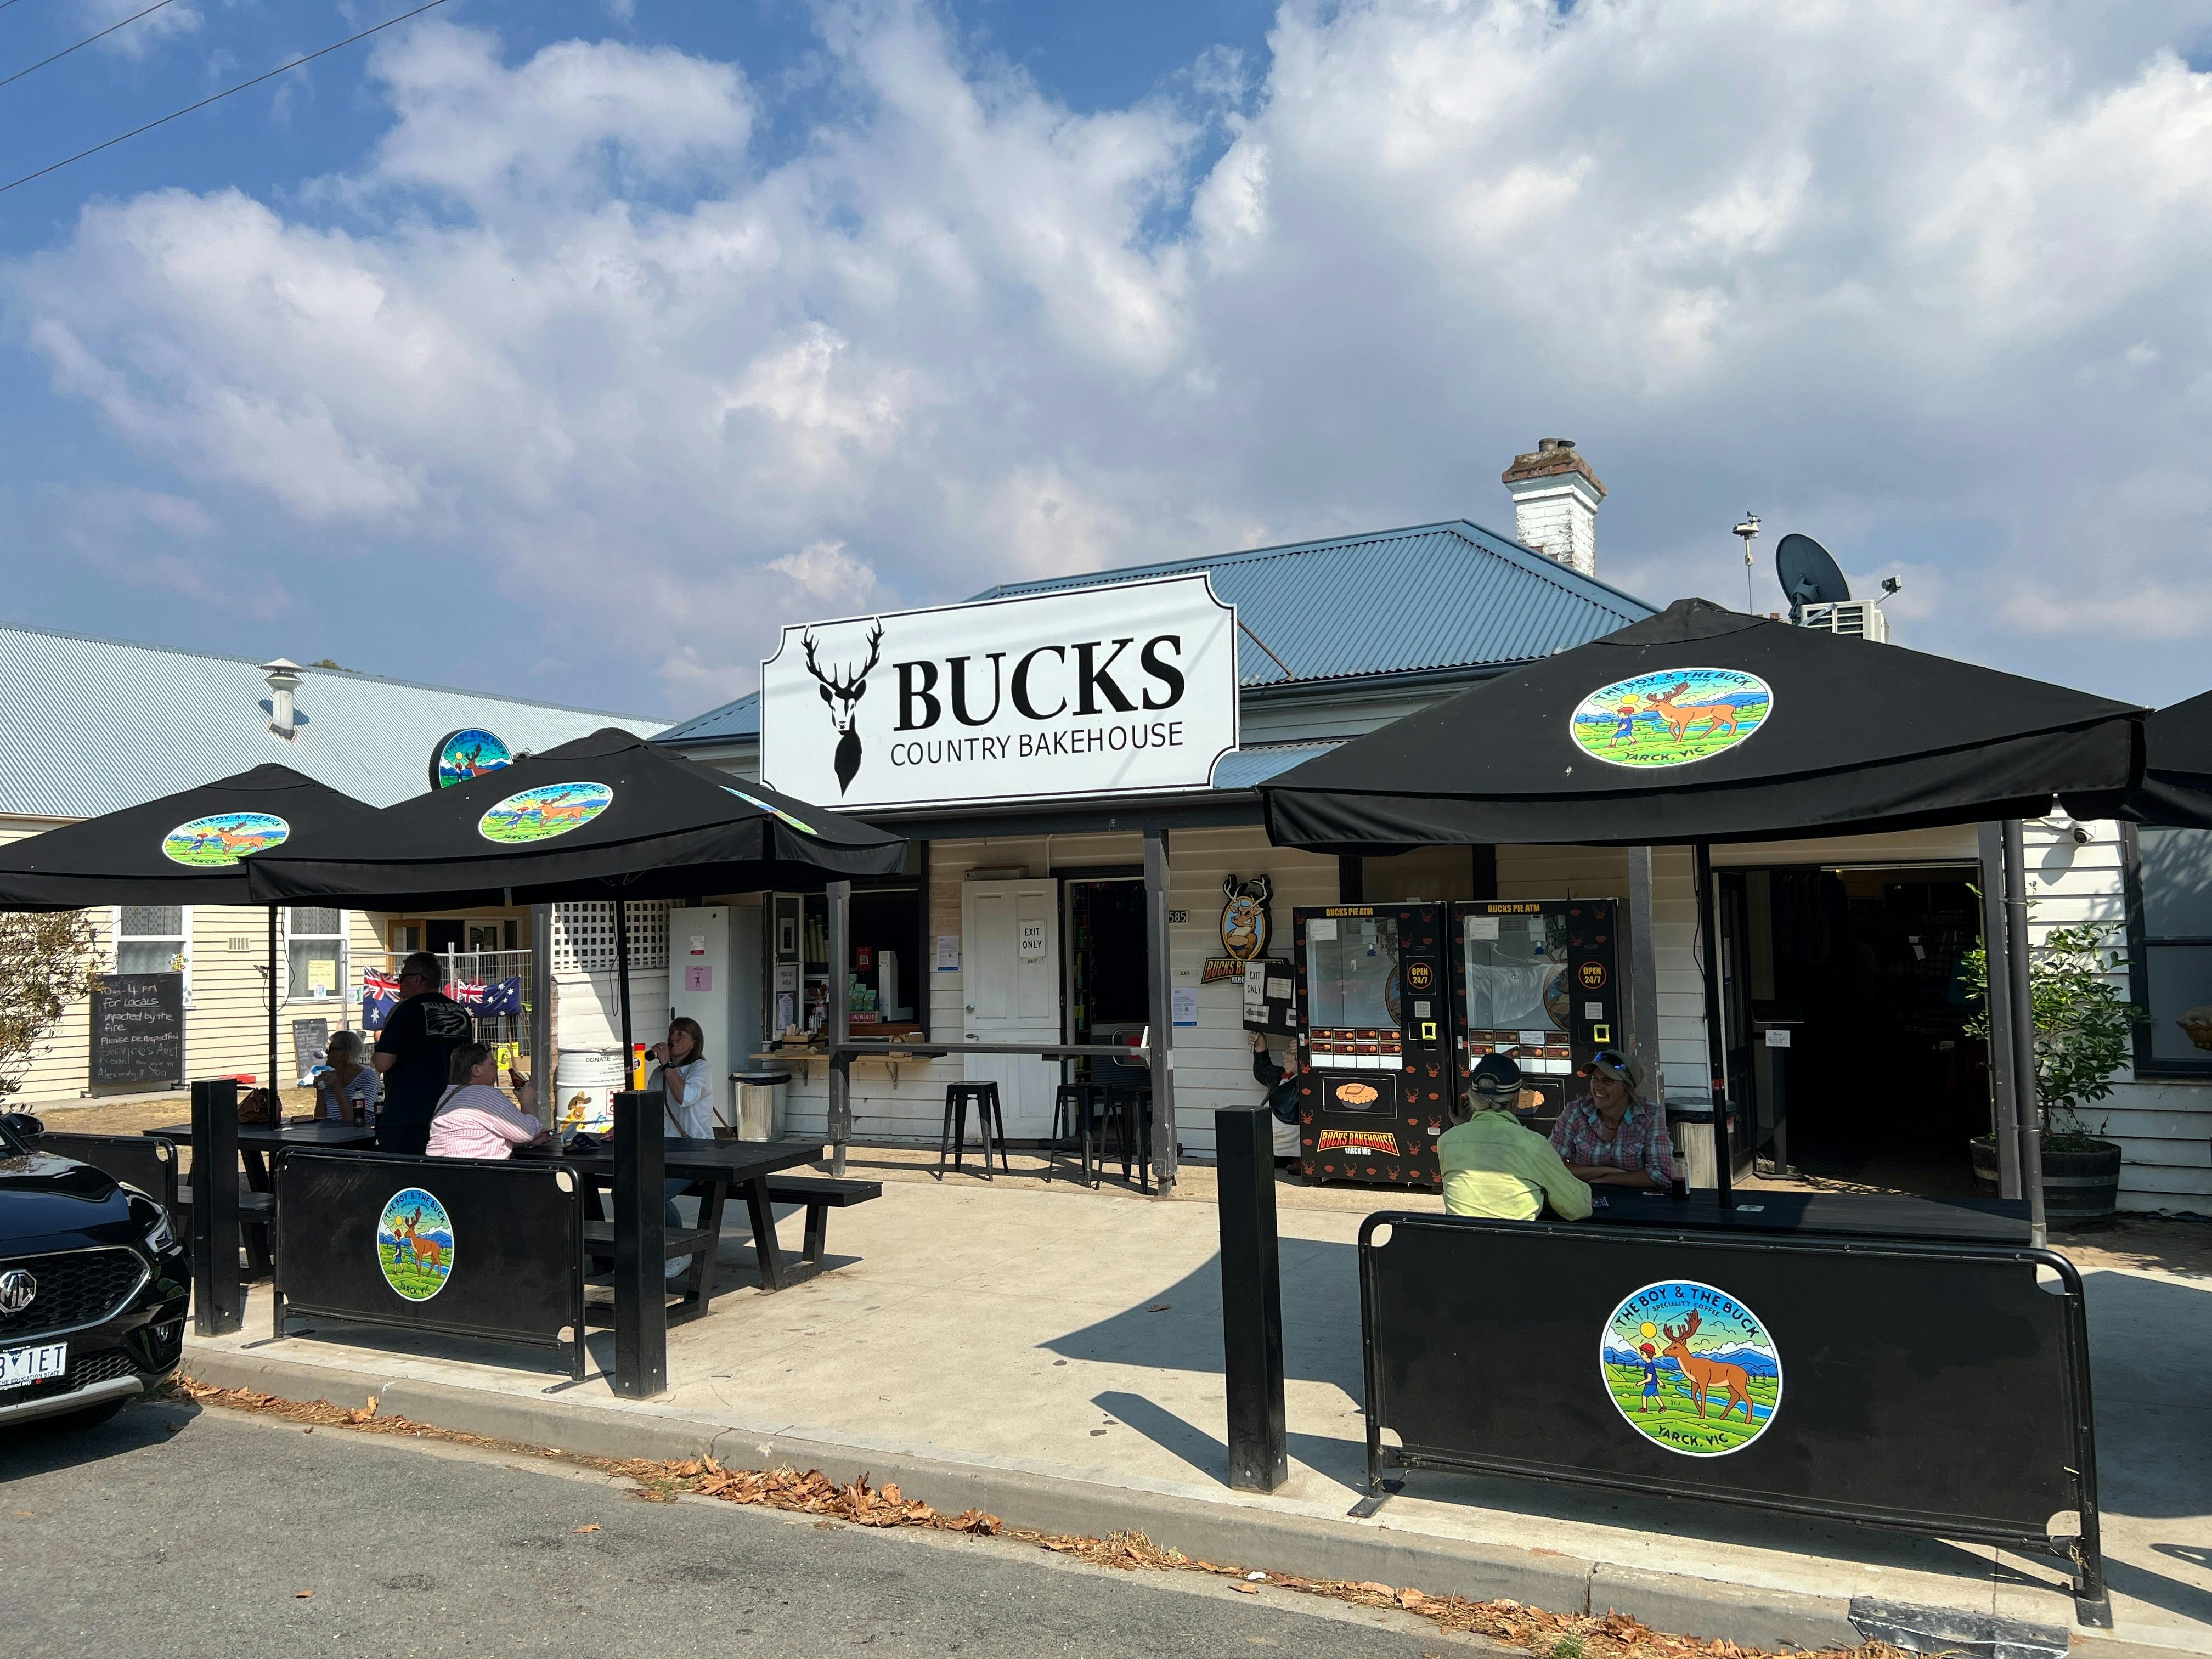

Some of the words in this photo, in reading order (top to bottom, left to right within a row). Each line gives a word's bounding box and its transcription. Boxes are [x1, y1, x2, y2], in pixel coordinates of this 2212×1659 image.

[893, 635, 1185, 732] BUCKS
[1595, 686, 1624, 701] THE
[1627, 676, 1656, 689] BOY
[1718, 672, 1754, 687] BUCK
[445, 742, 456, 755] THE
[456, 733, 467, 743] BOY
[478, 732, 490, 741] THE
[491, 738, 506, 755] BUCK
[891, 735, 1012, 767] COUNTRY
[1019, 721, 1184, 758] BAKEHOUSE
[1680, 746, 1706, 757] VIC
[509, 793, 532, 803] THE
[533, 786, 558, 795] BOY
[262, 816, 281, 827] BUCK
[1325, 909, 1348, 917] BUCKS
[1348, 908, 1359, 916] PIE
[1359, 907, 1373, 916] ATM
[1487, 905, 1512, 913] BUCKS
[1525, 904, 1541, 912] ATM
[1169, 912, 1186, 922] 585
[1025, 928, 1040, 936] EXIT
[1023, 940, 1042, 949] ONLY
[1205, 961, 1235, 979] BUCKS
[1249, 971, 1261, 980] EXIT
[1584, 975, 1601, 984] 24/7
[1247, 984, 1261, 994] ONLY
[145, 1012, 156, 1024] by
[157, 1012, 175, 1022] the
[105, 1023, 126, 1032] fire
[97, 1045, 154, 1057] Services
[1320, 1131, 1348, 1149] BUCKS
[1348, 1133, 1397, 1153] BAKEHOUSE
[385, 1203, 396, 1219] THE
[396, 1193, 408, 1207] BOY
[411, 1191, 415, 1199] &
[417, 1193, 431, 1205] THE
[430, 1201, 446, 1223] BUCK
[420, 1285, 430, 1294] VIC
[1615, 1302, 1640, 1327] THE
[1639, 1288, 1668, 1307] BOY
[1674, 1285, 1686, 1299] &
[1691, 1287, 1722, 1308] THE
[1723, 1301, 1760, 1338] BUCK
[1652, 1300, 1691, 1312] SPECIALITY
[1693, 1302, 1722, 1317] COFFEE
[27, 1345, 64, 1374] 1ET
[11, 1374, 42, 1384] EDUCATION
[1706, 1432, 1729, 1446] VIC
